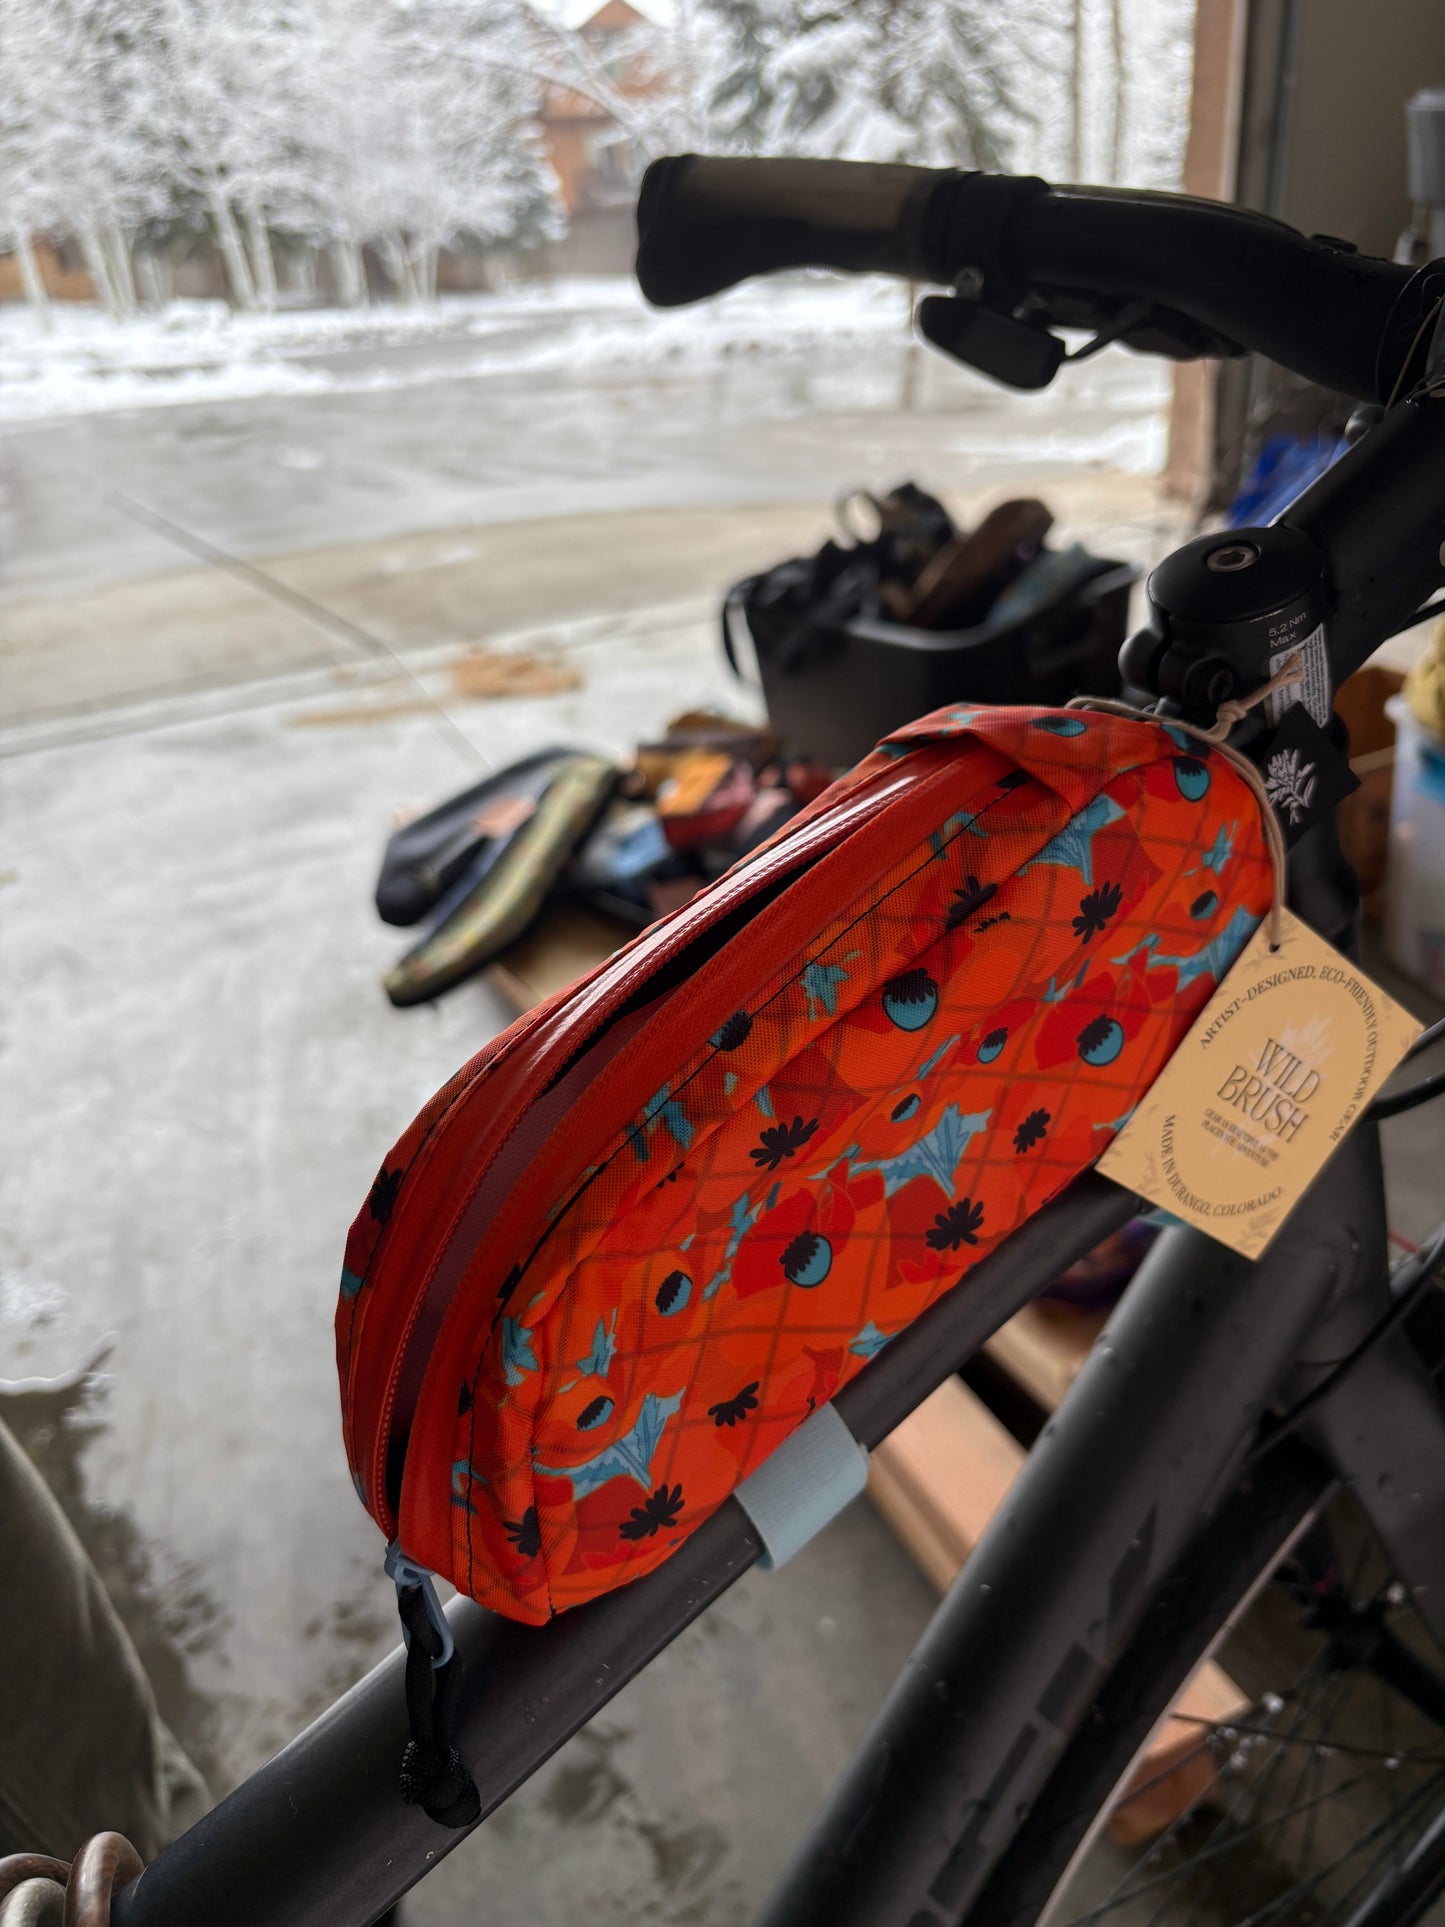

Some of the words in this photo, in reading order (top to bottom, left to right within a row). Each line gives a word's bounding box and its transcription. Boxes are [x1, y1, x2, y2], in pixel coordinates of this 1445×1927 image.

[1268, 623, 1288, 637] 5.2
[1289, 612, 1307, 628] Nm
[1270, 631, 1297, 648] Max
[1319, 966, 1378, 1030] ECO-FRIENDLY
[1256, 1038, 1320, 1103] WILD
[1353, 1031, 1378, 1101] OUTDOOR
[1217, 1065, 1309, 1143] BRUSH
[1329, 1103, 1357, 1141] GEAR
[1161, 1114, 1176, 1158] MADE
[1162, 1157, 1177, 1175] IN
[1212, 1187, 1281, 1216] COLORADO
